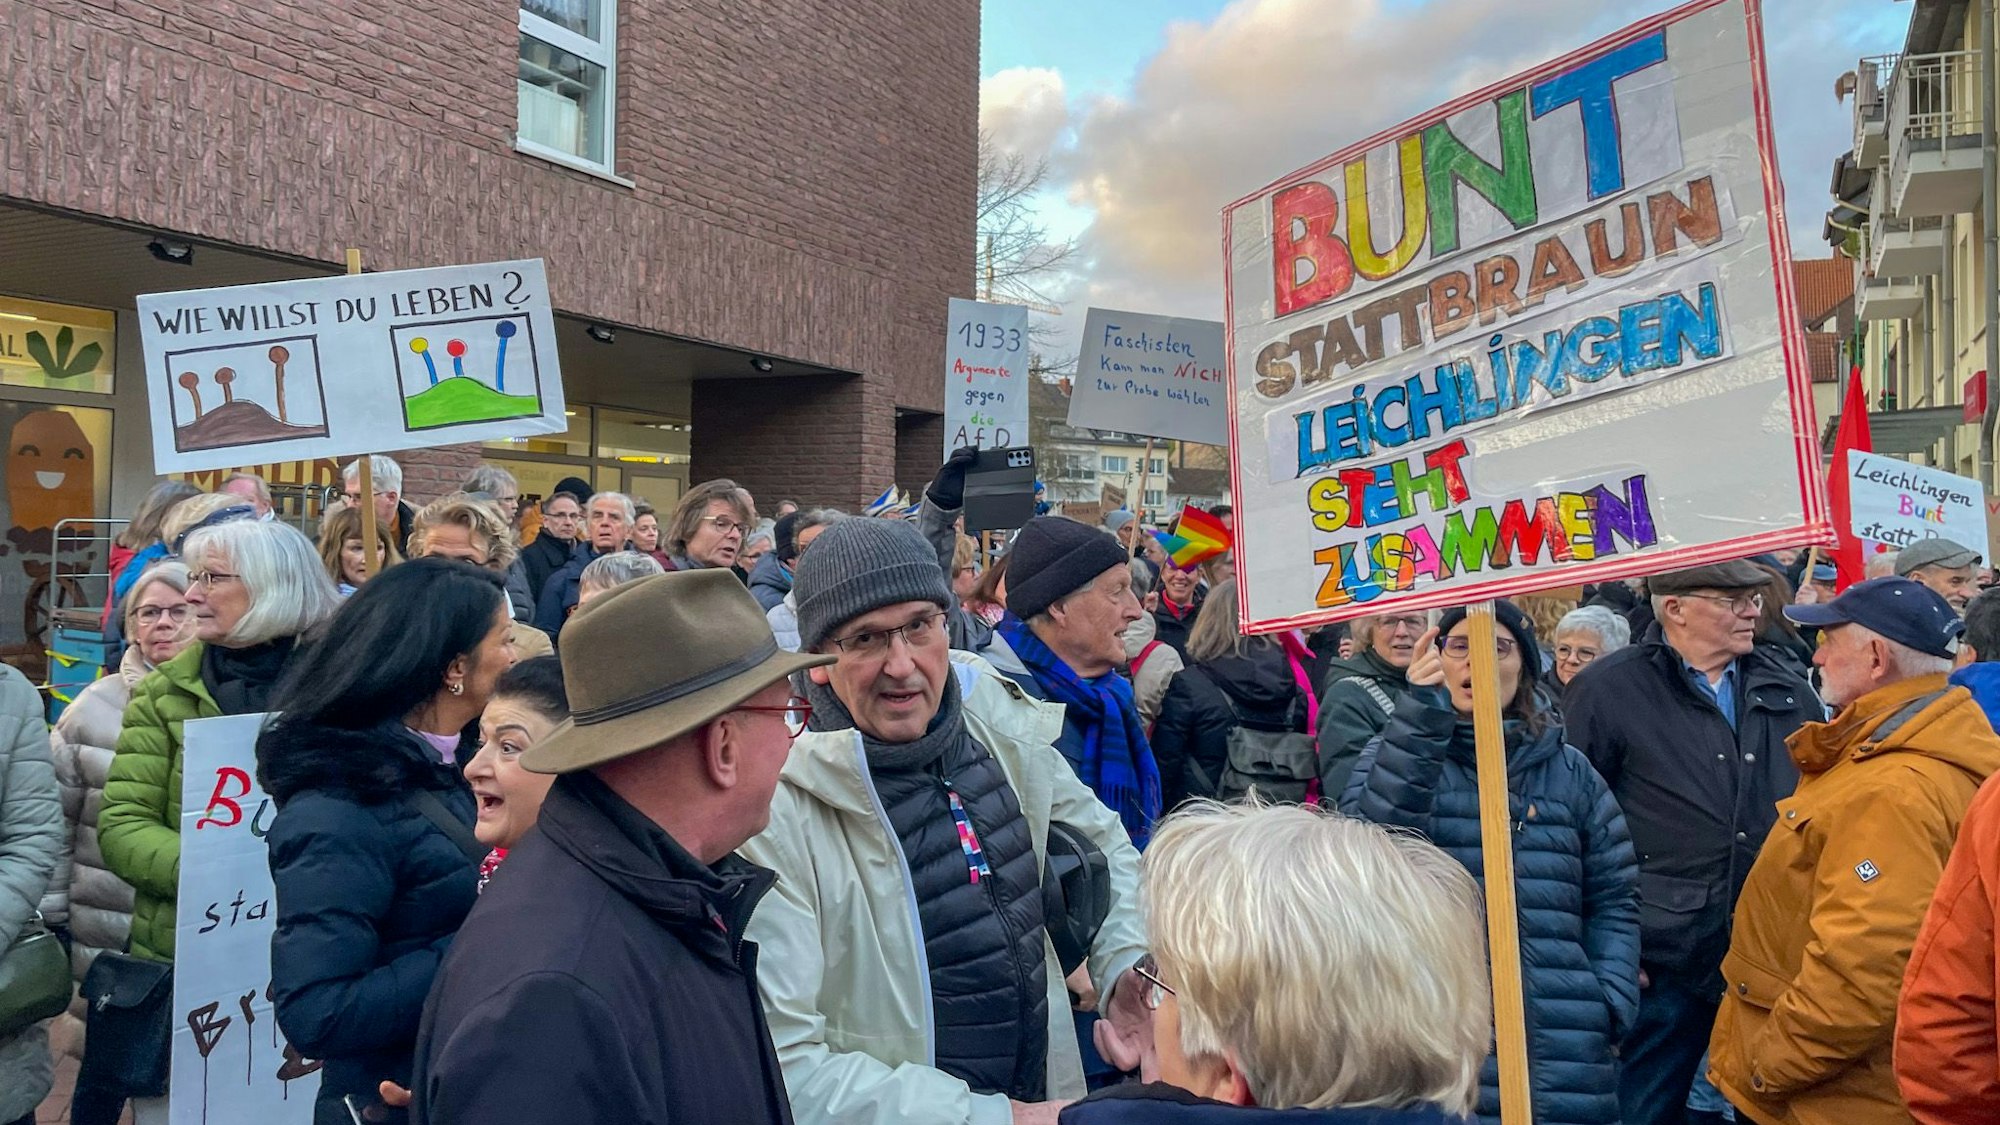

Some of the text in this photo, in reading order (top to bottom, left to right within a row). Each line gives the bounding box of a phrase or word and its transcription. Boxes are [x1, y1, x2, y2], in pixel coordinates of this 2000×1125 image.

[1273, 25, 1668, 318] BUNT
[153, 306, 211, 334] WIE
[217, 302, 320, 332] WILLST
[336, 297, 377, 323] DU
[959, 321, 1021, 352] 1933
[1103, 324, 1195, 358] Faschisten
[954, 357, 1011, 383] Argumente
[1140, 364, 1165, 375] man
[965, 390, 1005, 405] gegen
[1125, 380, 1159, 397] Probe
[971, 409, 994, 425] die
[954, 425, 1010, 449] AfD
[1307, 438, 1470, 532] STEHT
[1854, 458, 1973, 507] Leichlingen
[1898, 494, 1947, 524] Bunt
[1314, 474, 1657, 607] ZUSAMMEN
[1861, 522, 1918, 546] statt
